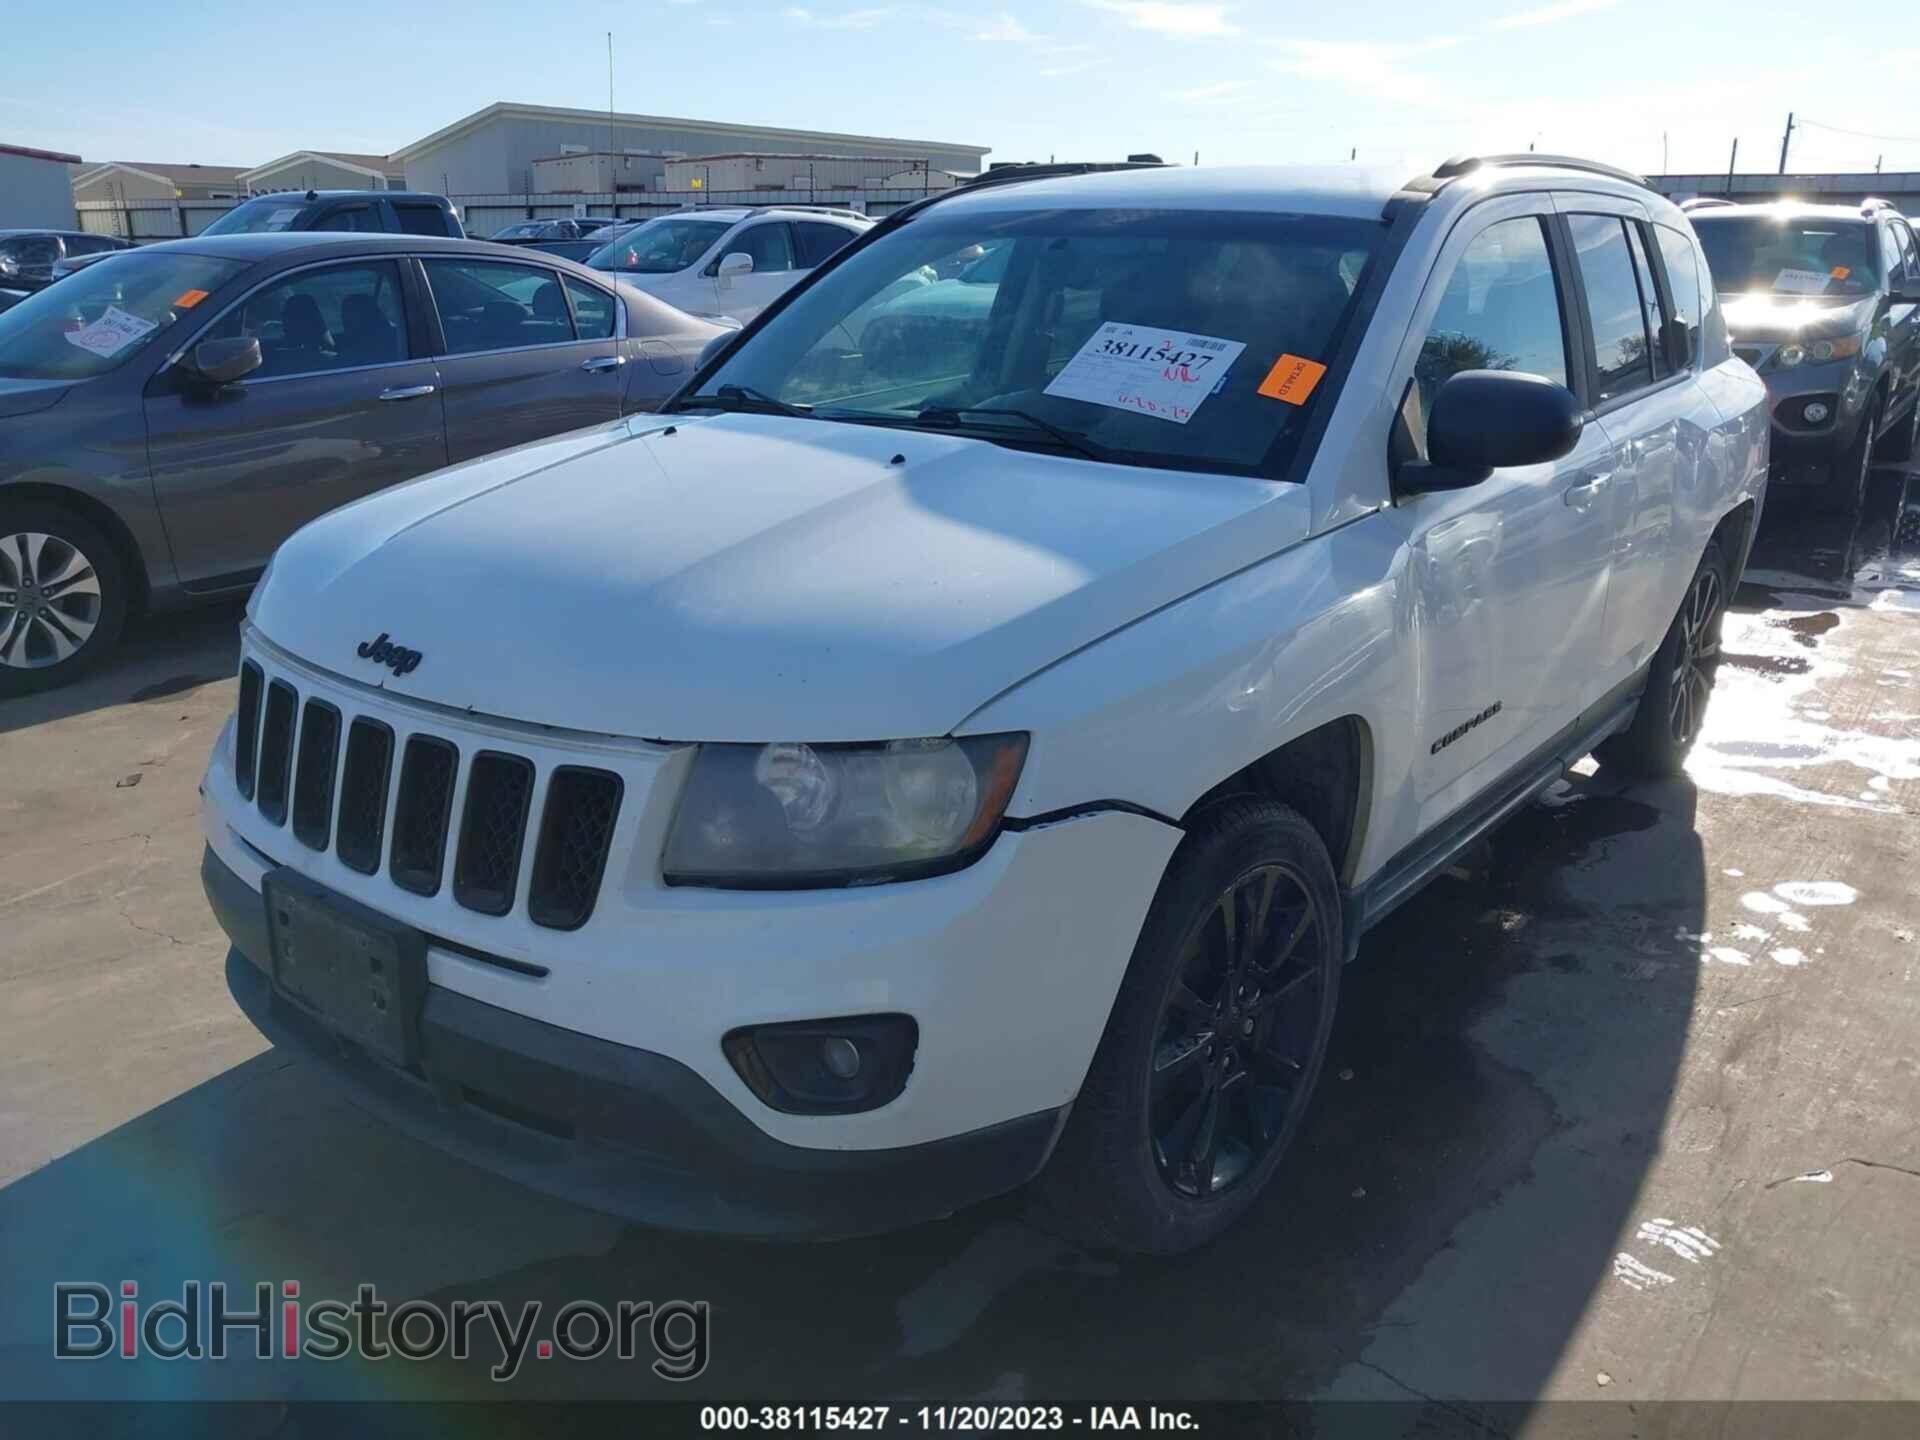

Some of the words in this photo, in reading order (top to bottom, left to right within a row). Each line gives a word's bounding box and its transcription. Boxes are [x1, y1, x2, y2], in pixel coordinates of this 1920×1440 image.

[1095, 339, 1214, 370] 38115427
[1279, 361, 1306, 396] DETAILED
[357, 632, 423, 677] Jeep
[1430, 700, 1503, 755] COMPASS
